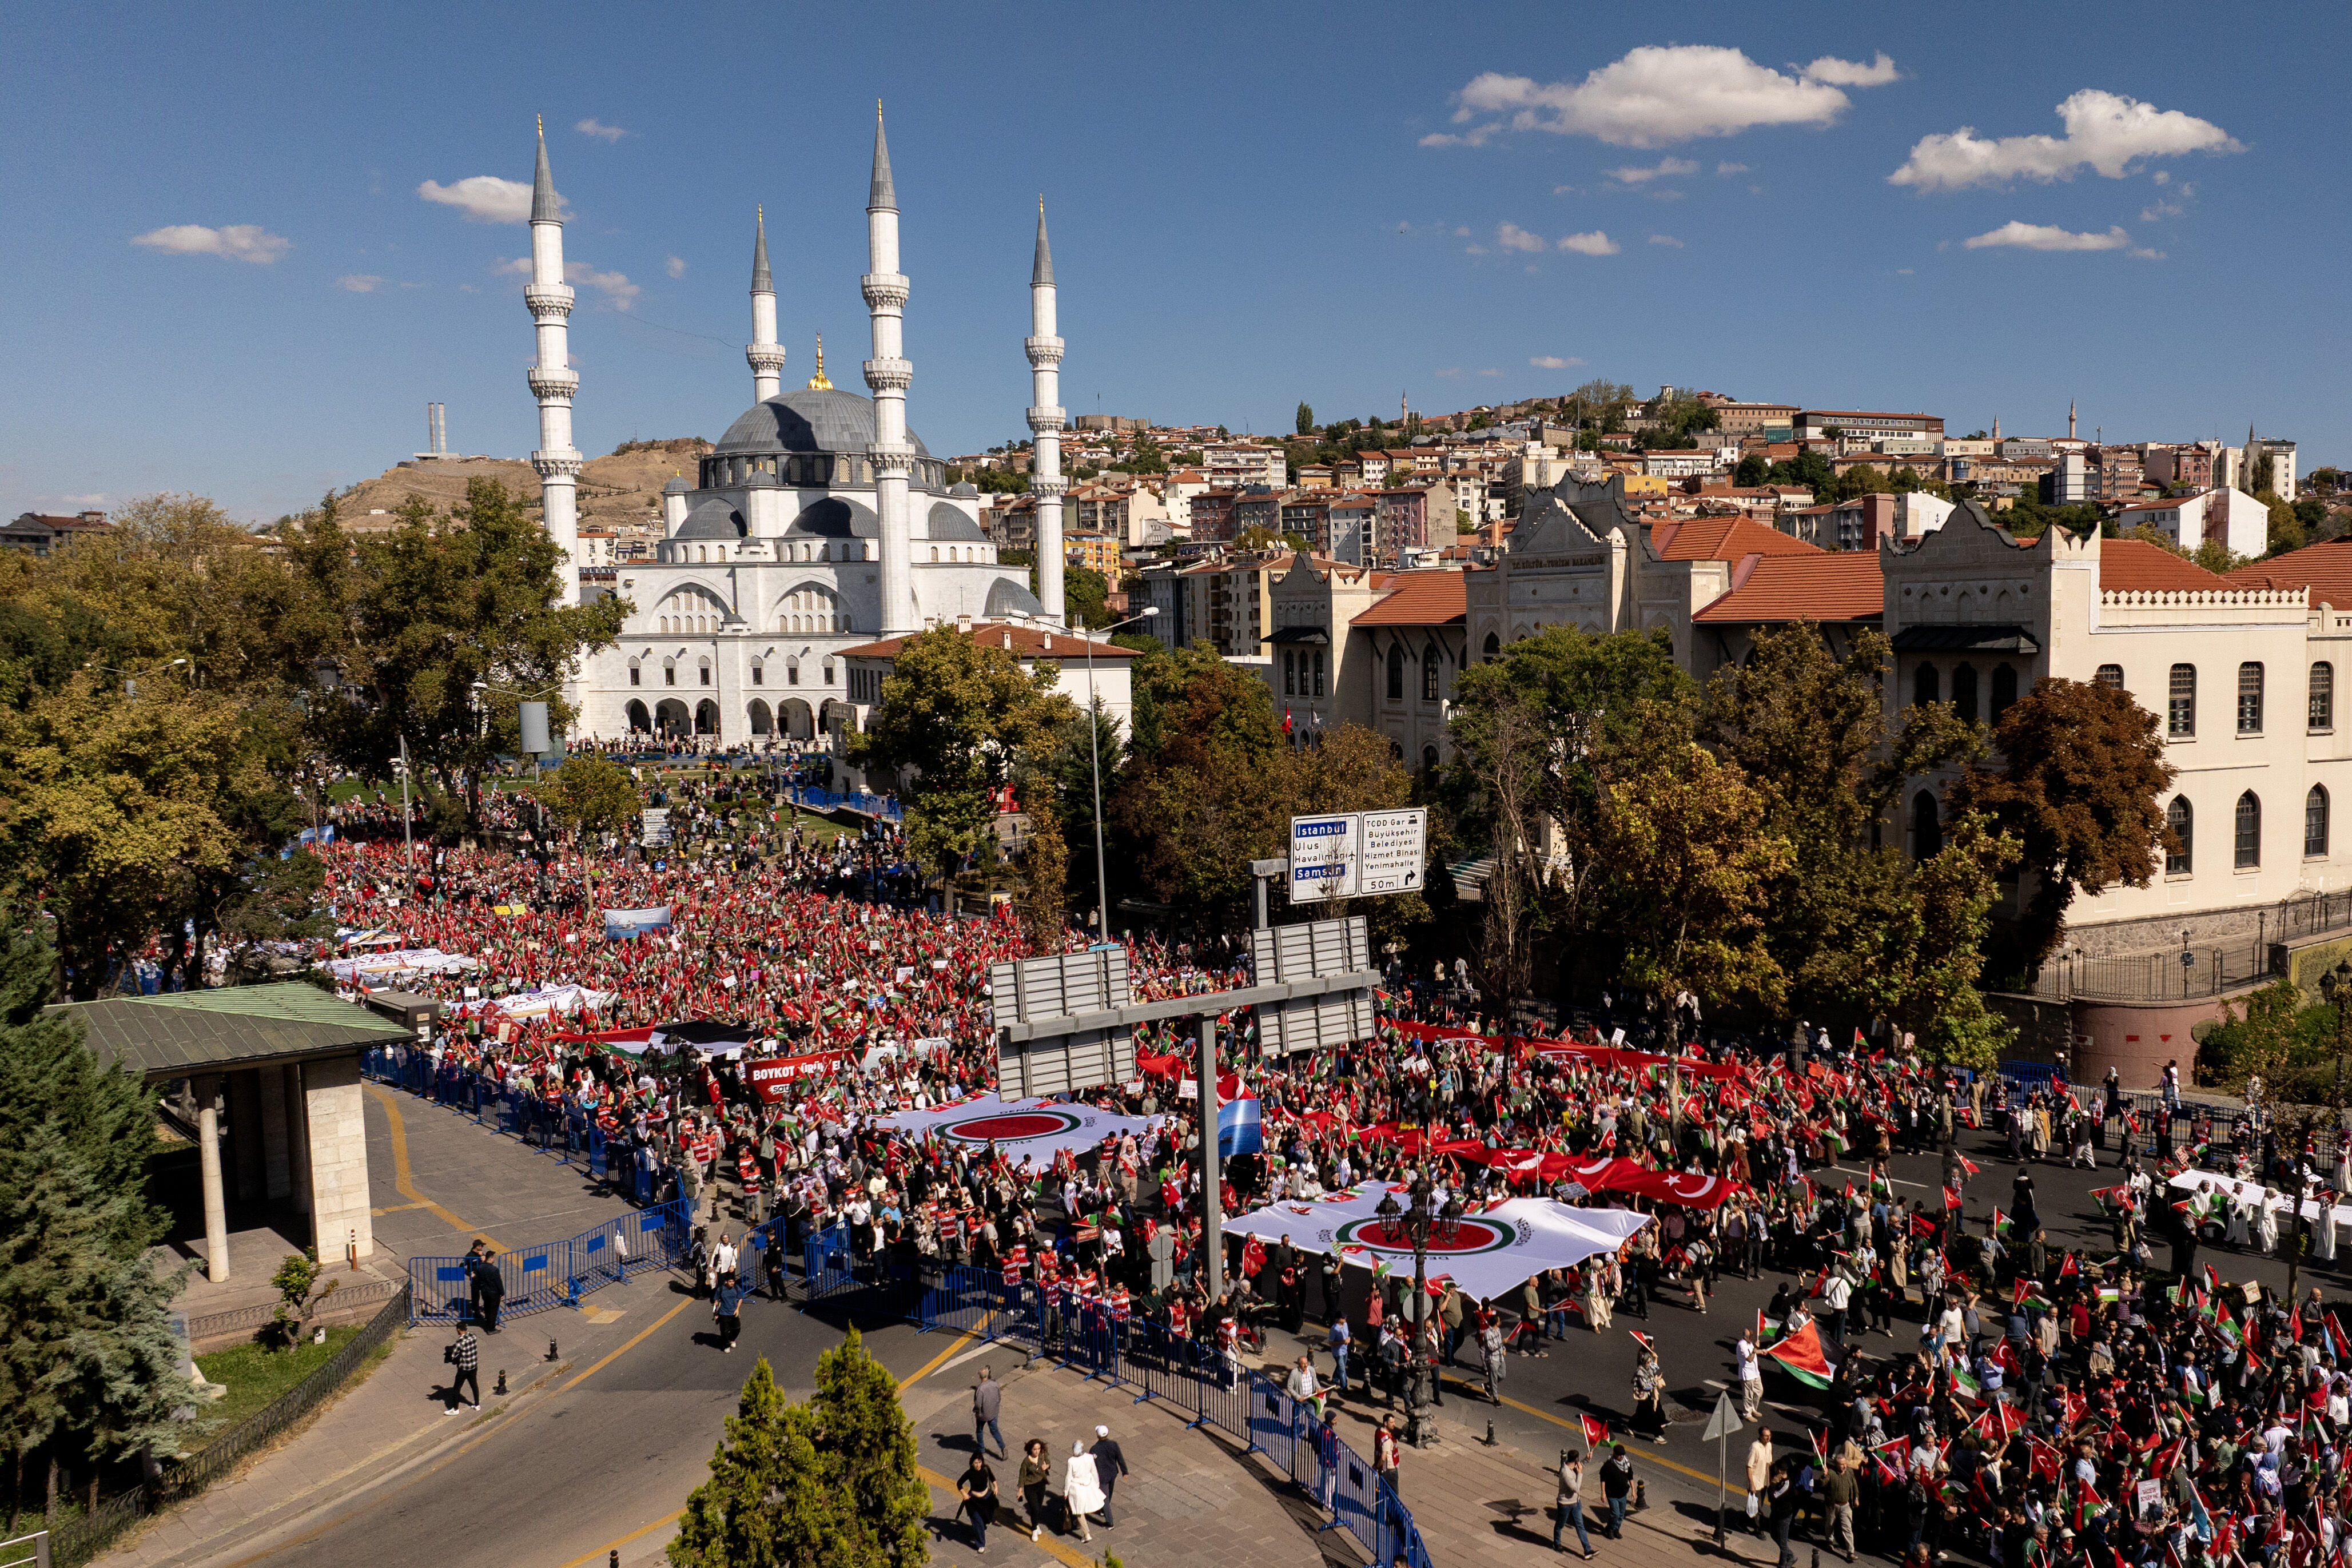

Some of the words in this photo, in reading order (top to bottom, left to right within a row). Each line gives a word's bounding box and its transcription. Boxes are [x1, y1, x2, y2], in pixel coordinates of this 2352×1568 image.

[1366, 819, 1387, 827] TCDD
[1298, 823, 1344, 836] İstanbul
[1368, 829, 1417, 838] Büyükşehir
[1295, 842, 1319, 851] Ulus
[1371, 838, 1415, 848] Belediyesi
[1295, 853, 1348, 863] Havalimanı
[1364, 851, 1393, 859] Hizmet
[1365, 859, 1414, 869] Yenimahalle
[753, 1065, 795, 1081] BOYKOT
